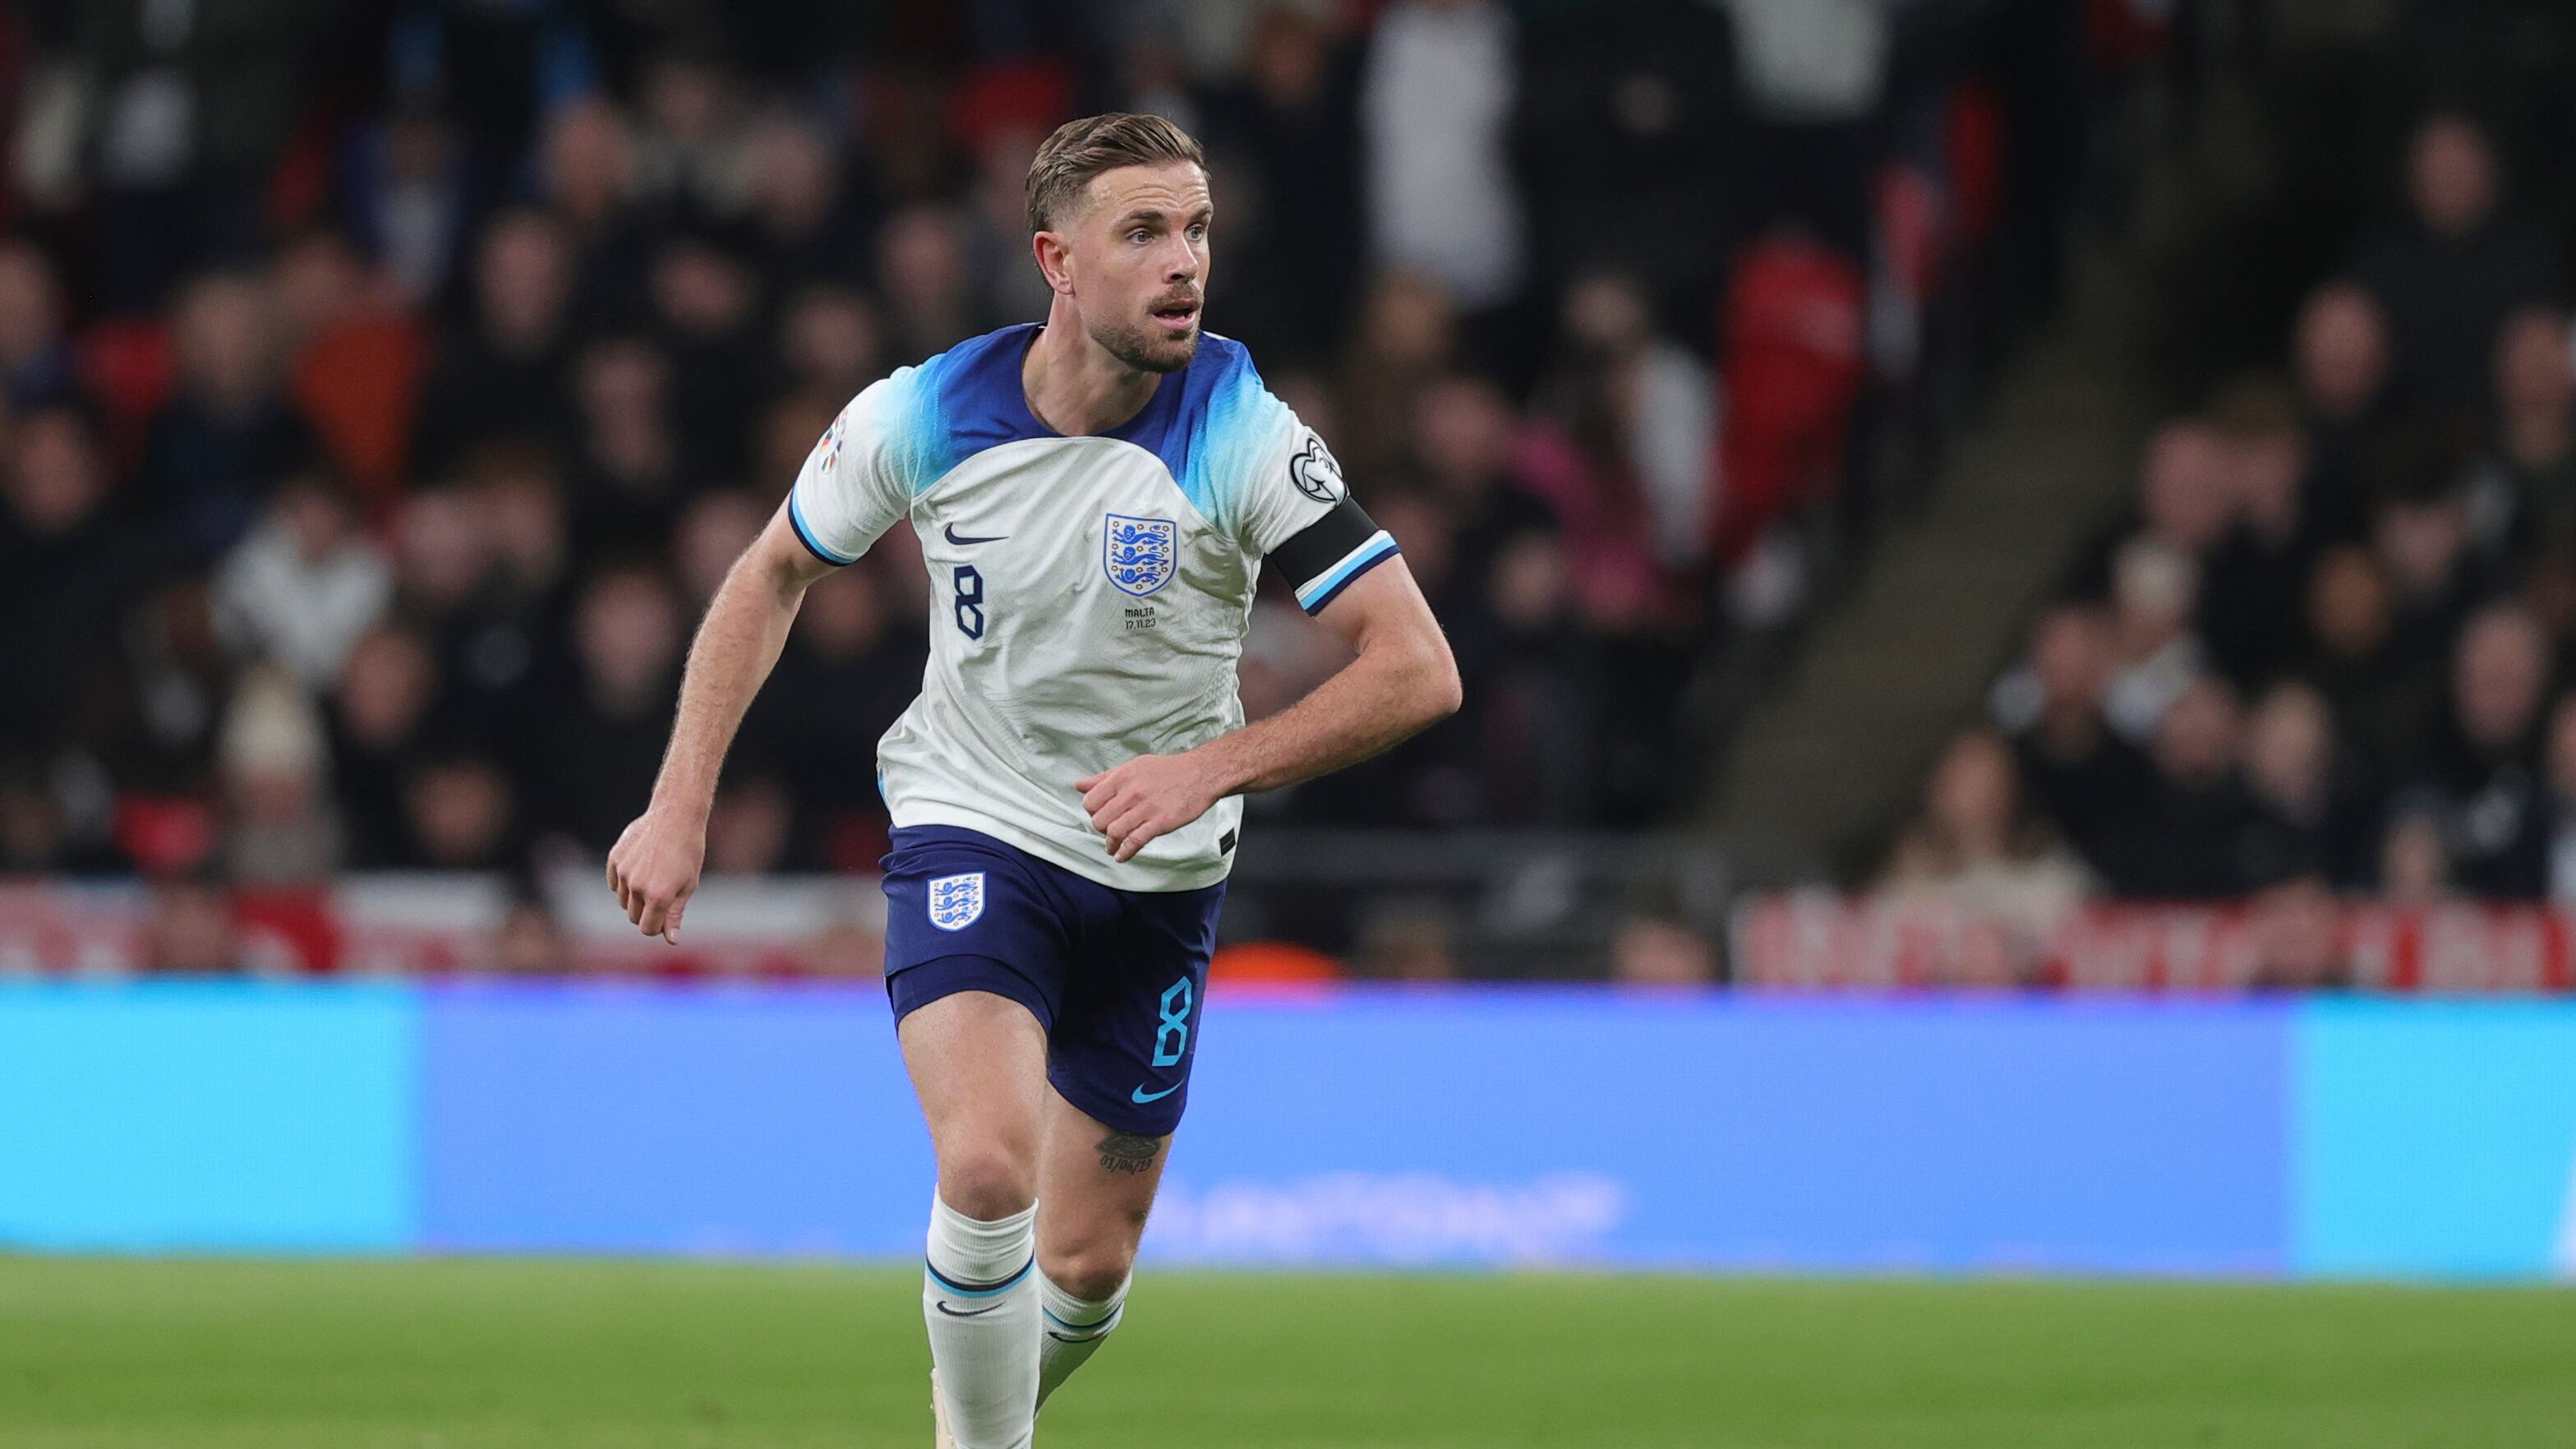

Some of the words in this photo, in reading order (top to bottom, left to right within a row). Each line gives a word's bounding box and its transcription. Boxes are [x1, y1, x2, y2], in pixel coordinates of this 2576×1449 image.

[953, 565, 984, 641] 8
[1125, 607, 1154, 617] MALTA
[1125, 618, 1156, 630] 17.11.23
[1151, 976, 1192, 1067] 8
